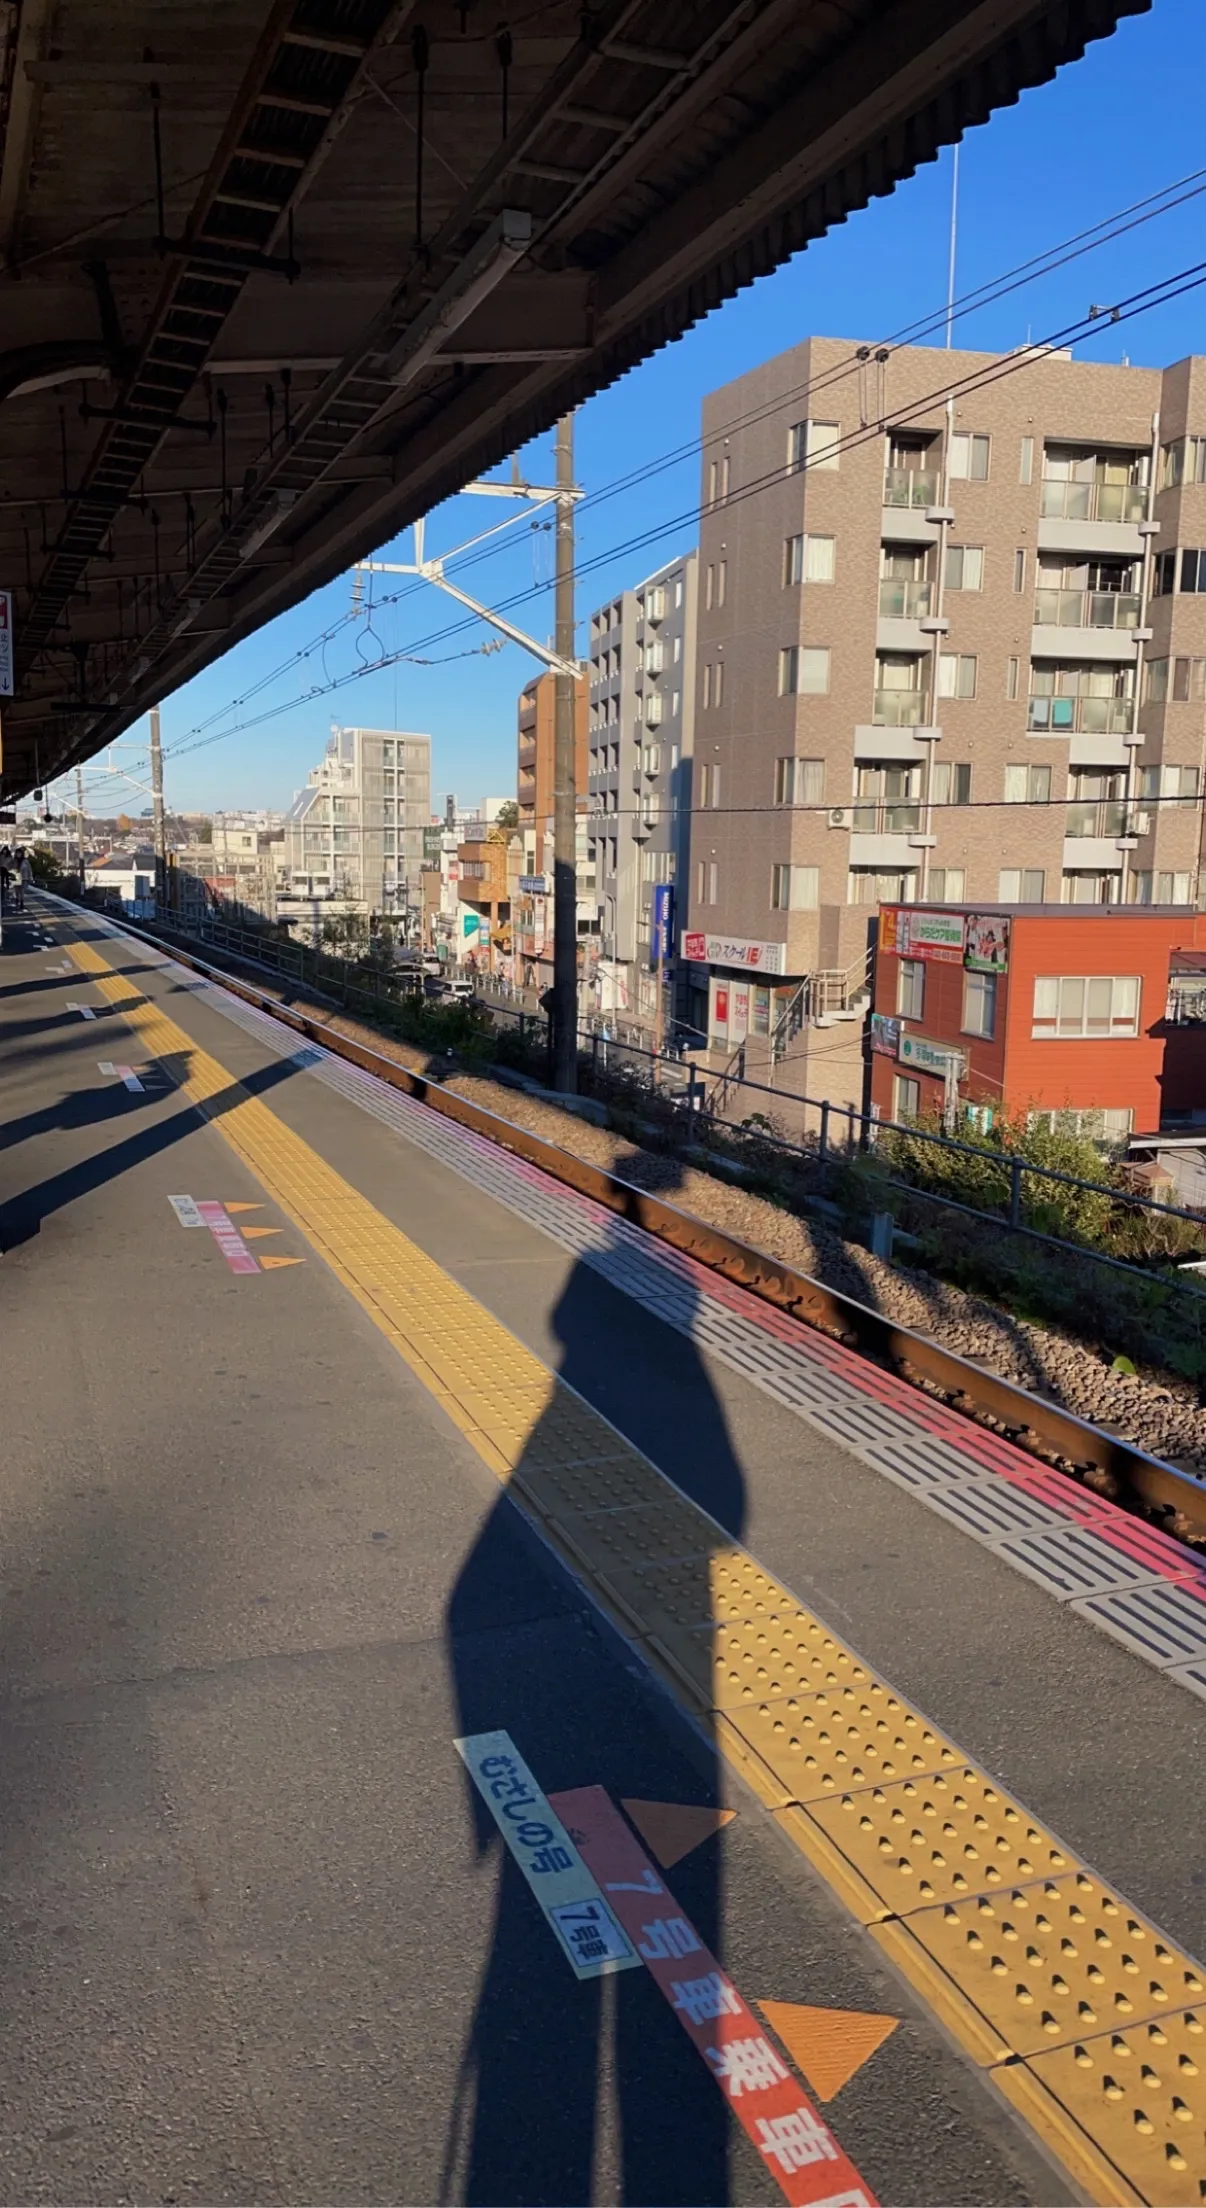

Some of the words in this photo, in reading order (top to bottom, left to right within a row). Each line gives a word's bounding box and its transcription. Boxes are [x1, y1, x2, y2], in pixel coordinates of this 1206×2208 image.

[478, 1754, 573, 1874] むさしの号
[559, 1904, 610, 1959] 7号車
